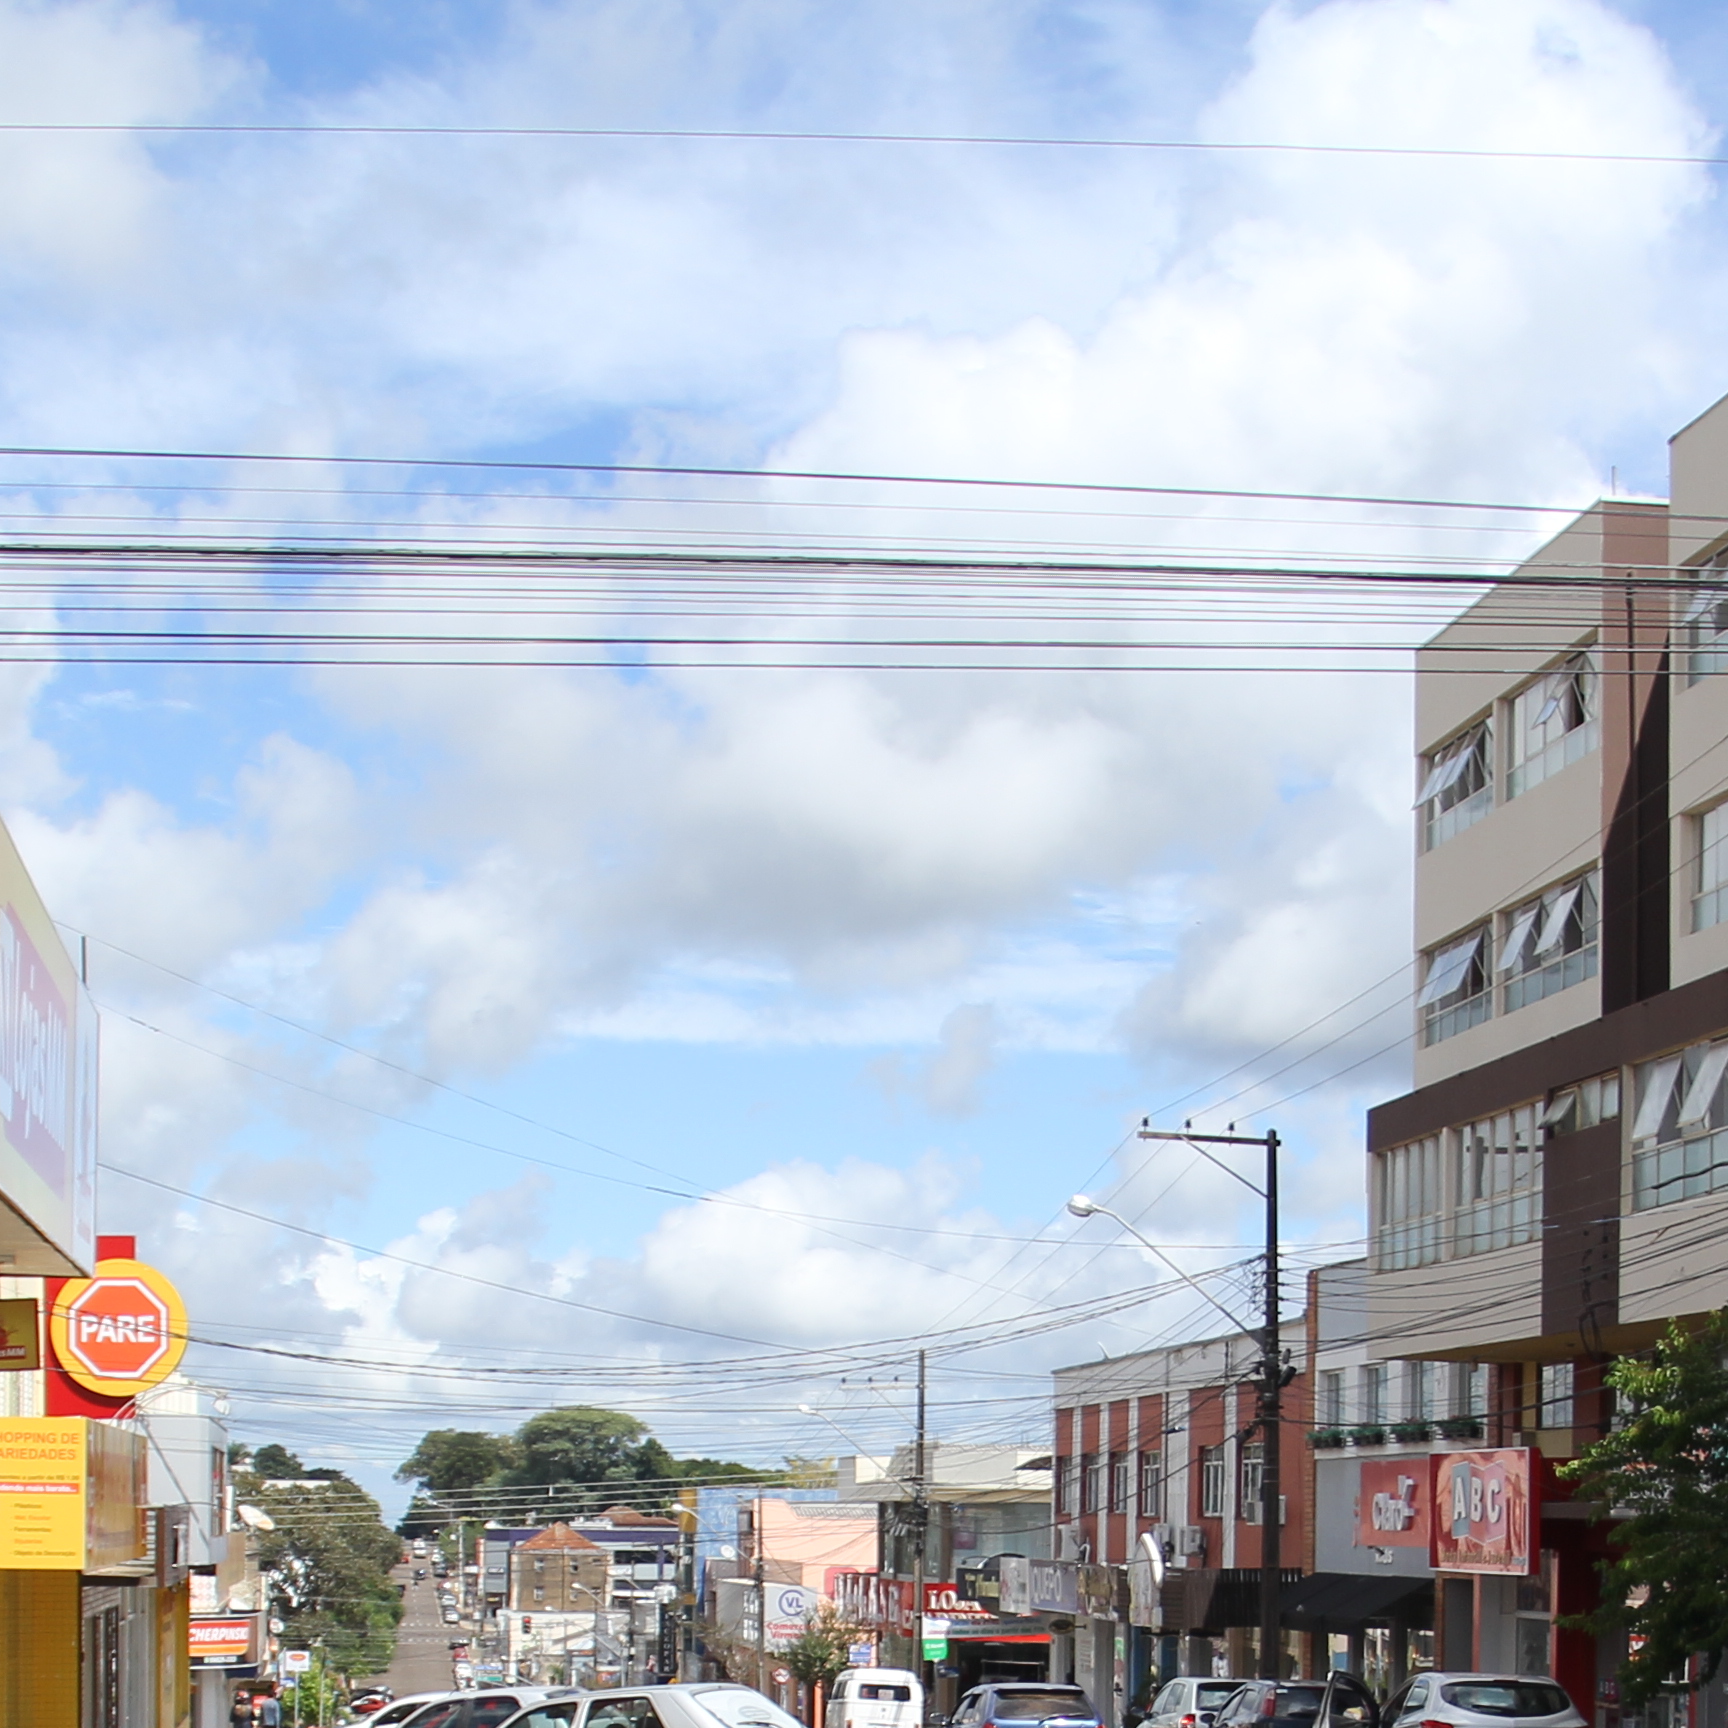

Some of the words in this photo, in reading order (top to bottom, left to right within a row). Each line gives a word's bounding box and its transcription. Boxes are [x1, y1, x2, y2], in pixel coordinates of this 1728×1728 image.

[80, 1314, 156, 1343] PARE
[60, 1432, 80, 1445] DE
[1452, 1475, 1502, 1525] ABC
